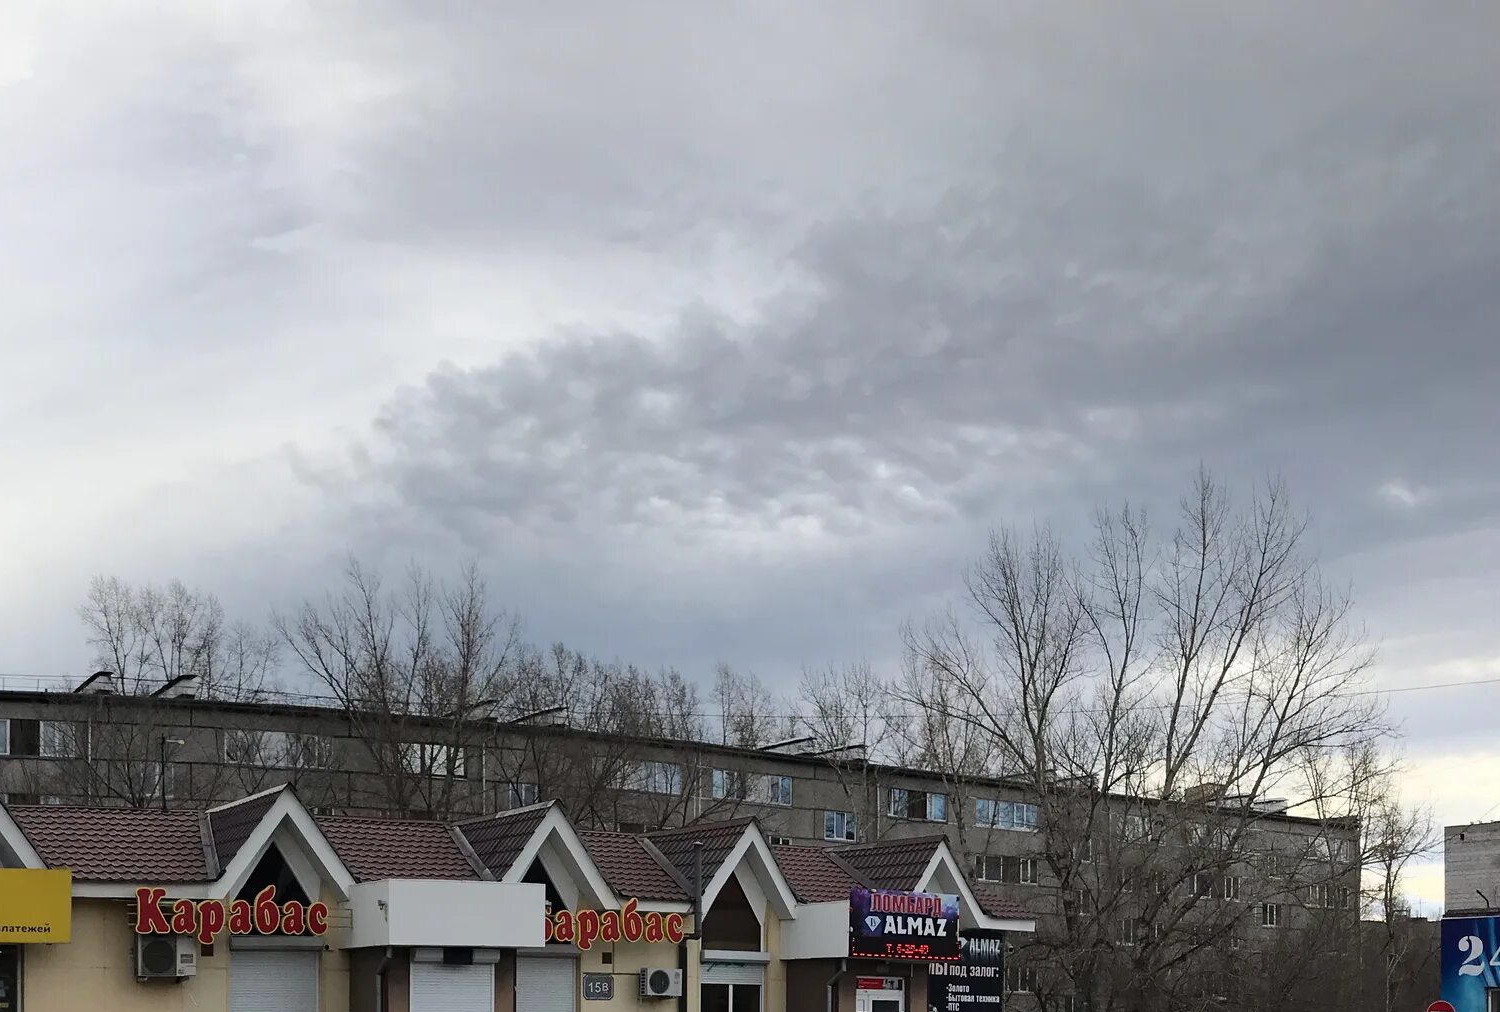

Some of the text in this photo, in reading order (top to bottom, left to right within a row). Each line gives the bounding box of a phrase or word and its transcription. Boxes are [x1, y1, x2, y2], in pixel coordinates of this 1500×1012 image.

[135, 884, 329, 945] Карабас
[870, 893, 942, 917] ЛОМБАРД
[883, 915, 948, 937] ALMAZ
[969, 937, 1000, 952] ALMAZ
[949, 965, 967, 978] под
[969, 966, 999, 977] залог:
